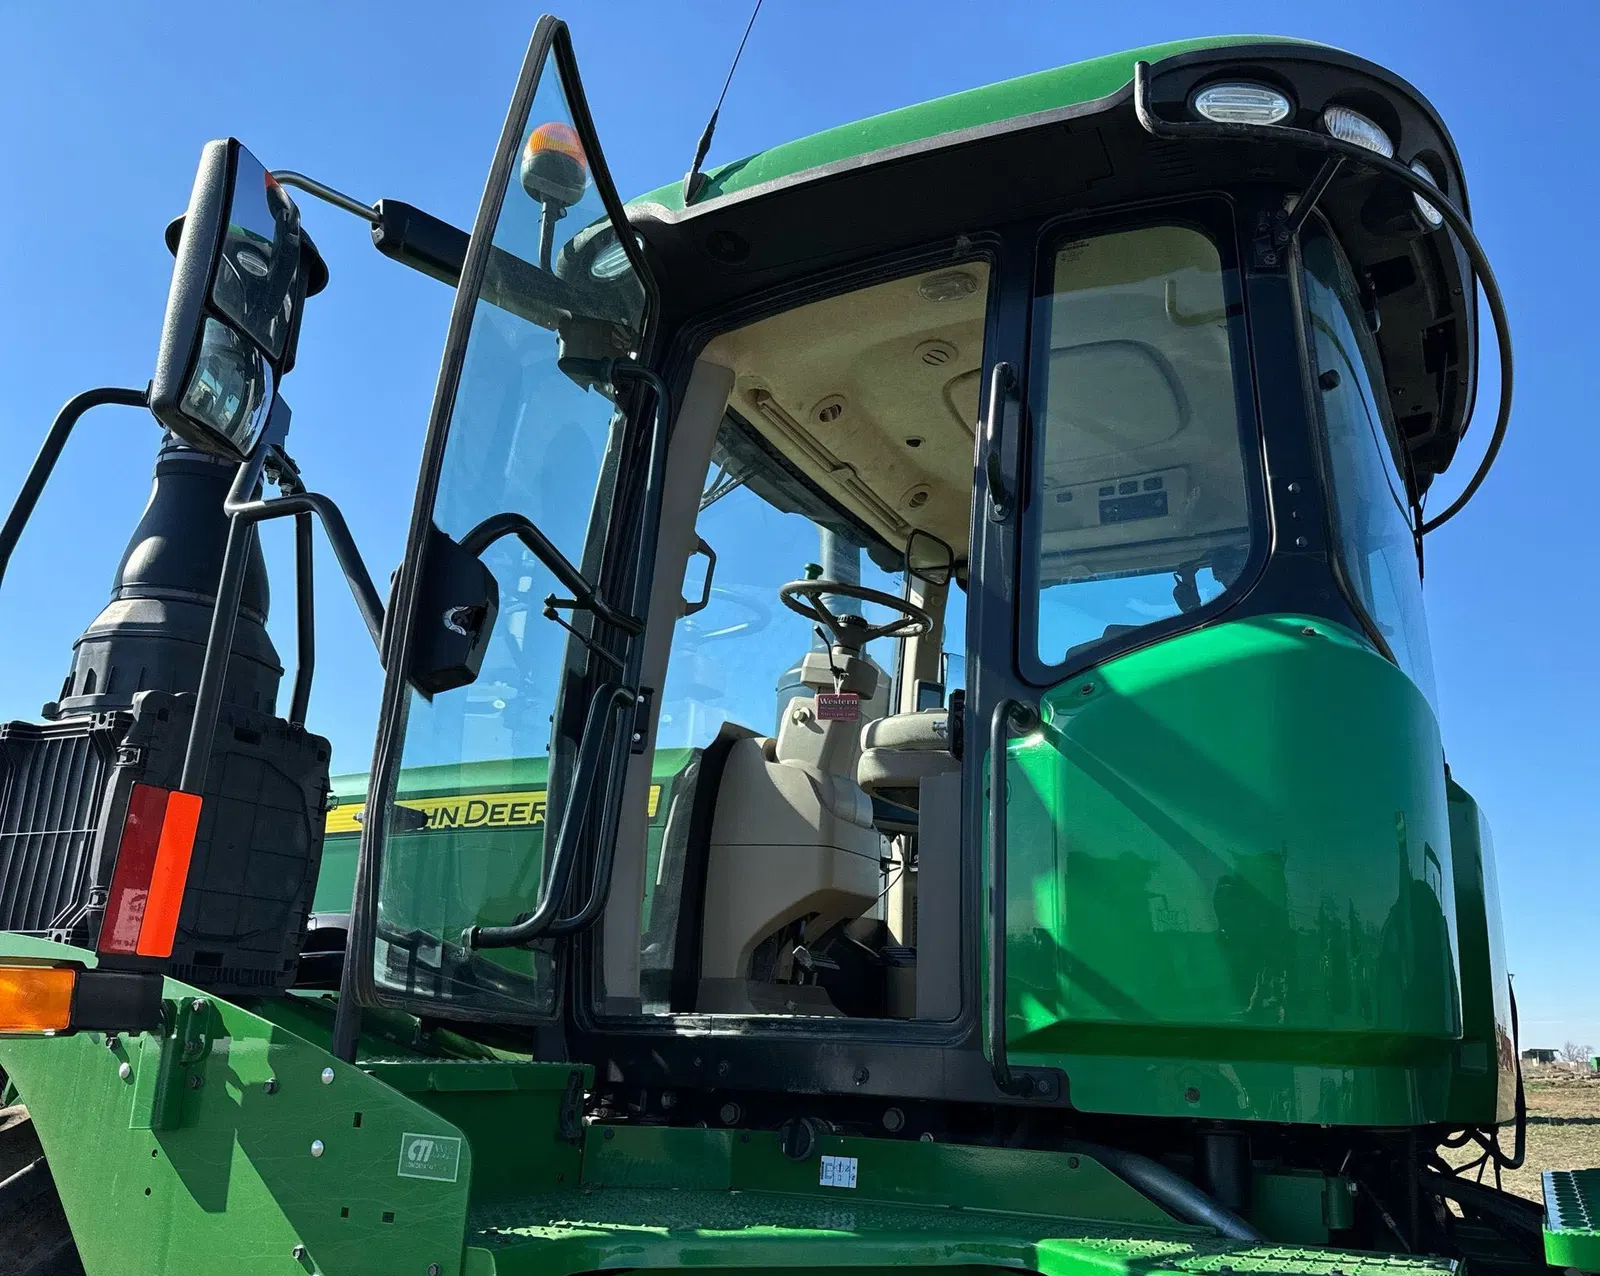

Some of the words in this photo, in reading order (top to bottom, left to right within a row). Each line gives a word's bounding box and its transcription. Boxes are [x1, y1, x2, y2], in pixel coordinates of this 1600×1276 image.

[819, 697, 858, 705] Western
[421, 806, 460, 827] HN
[464, 800, 547, 825] DEER
